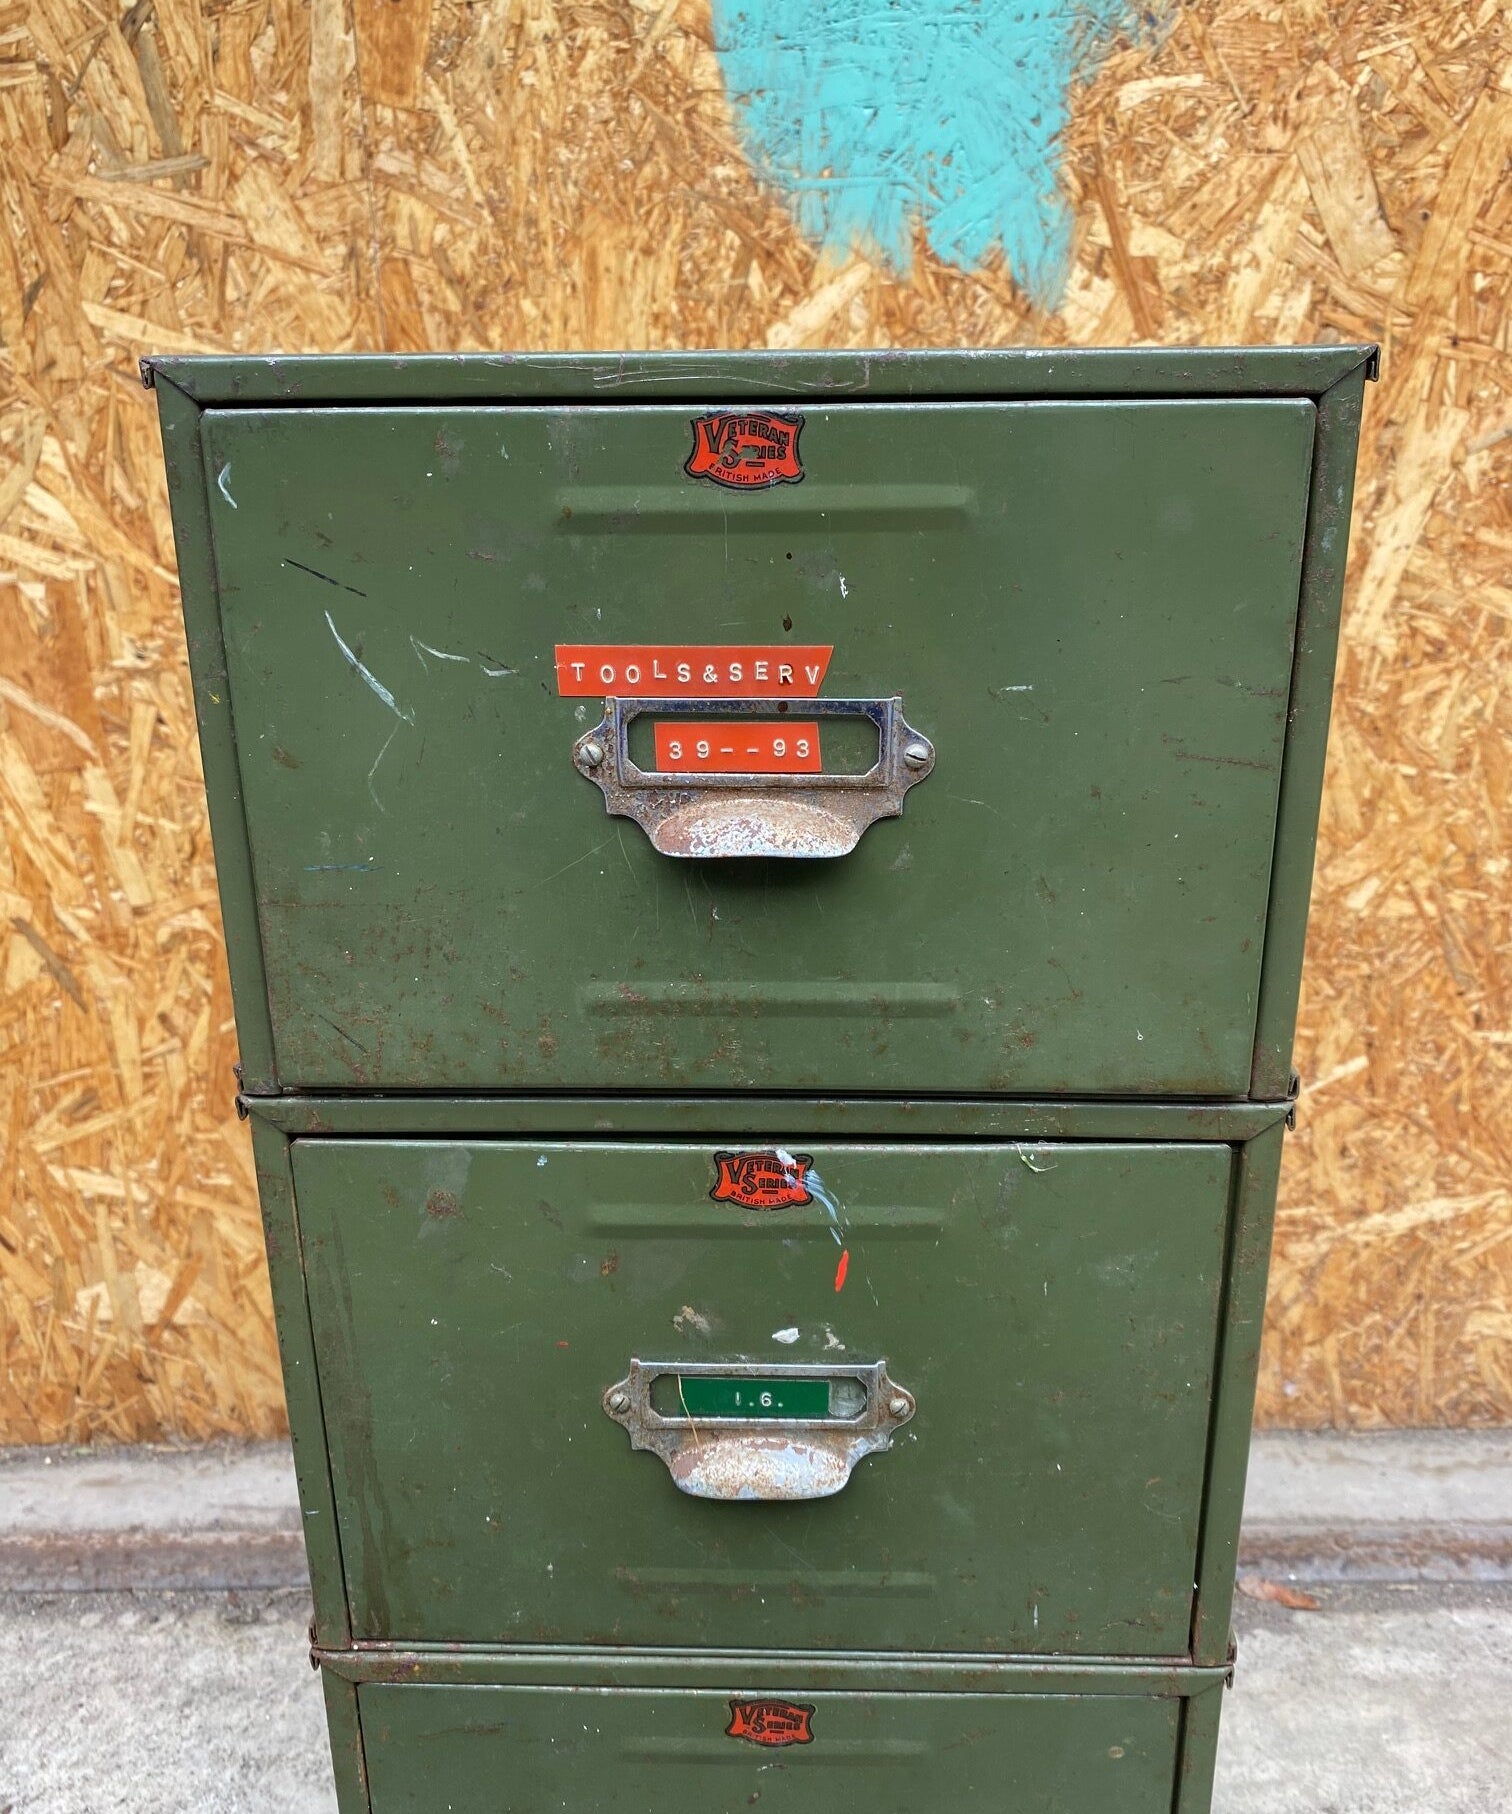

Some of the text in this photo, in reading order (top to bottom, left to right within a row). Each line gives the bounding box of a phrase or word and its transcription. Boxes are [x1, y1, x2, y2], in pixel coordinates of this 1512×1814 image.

[704, 414, 790, 454] VETERAN
[753, 466, 782, 481] MADE
[570, 659, 820, 686] TOOLS&SERV
[730, 1190, 765, 1205] BRITISH
